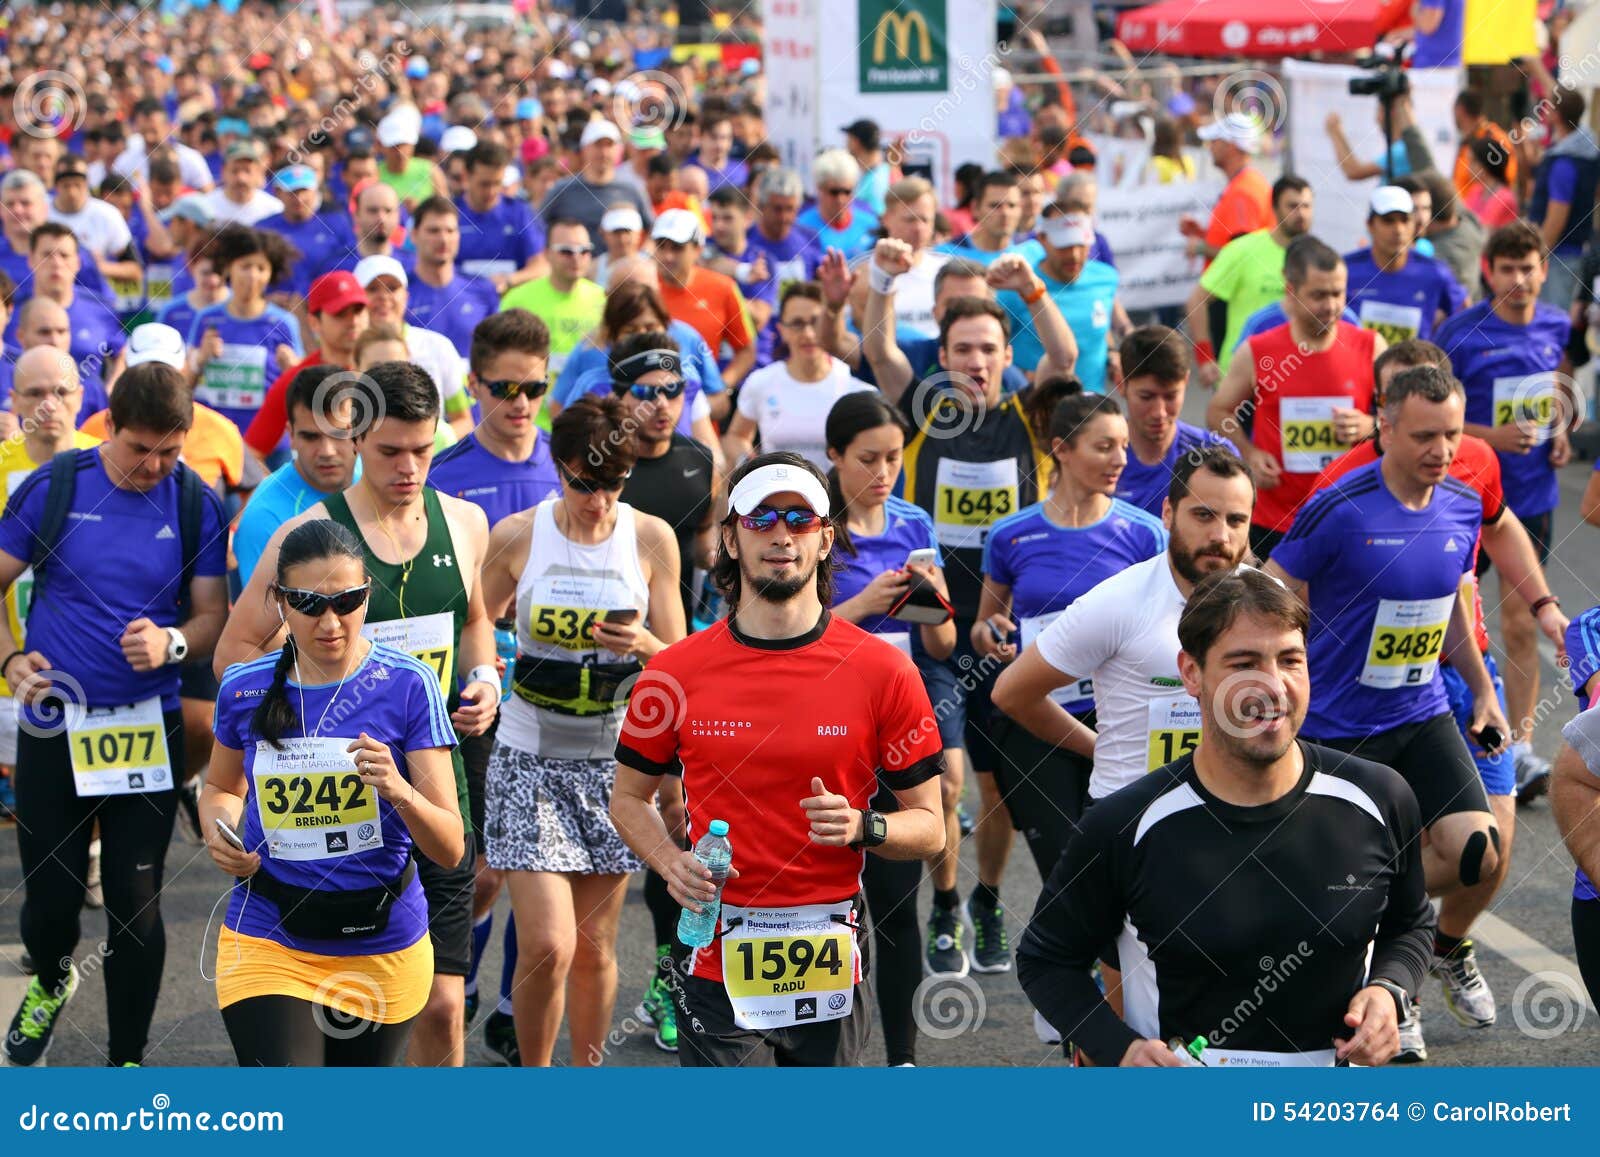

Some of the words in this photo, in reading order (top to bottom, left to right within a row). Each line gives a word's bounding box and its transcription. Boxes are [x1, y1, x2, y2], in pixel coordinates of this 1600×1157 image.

[1286, 426, 1345, 447] 204
[944, 489, 1010, 515] 1643
[1376, 629, 1442, 660] 3482
[417, 650, 447, 683] 7
[692, 720, 752, 728] CLIFFORD
[692, 729, 735, 737] CHANCE
[817, 726, 847, 736] RADU
[80, 731, 155, 766] 1077
[265, 774, 367, 814] 3242
[295, 815, 341, 827] BRENDA
[747, 920, 790, 929] Bucharest
[737, 938, 842, 981] 1594
[773, 981, 806, 994] RADU
[762, 1009, 787, 1017] Petrom
[1230, 1057, 1249, 1065] OMV
[1252, 1058, 1280, 1067] Petrom
